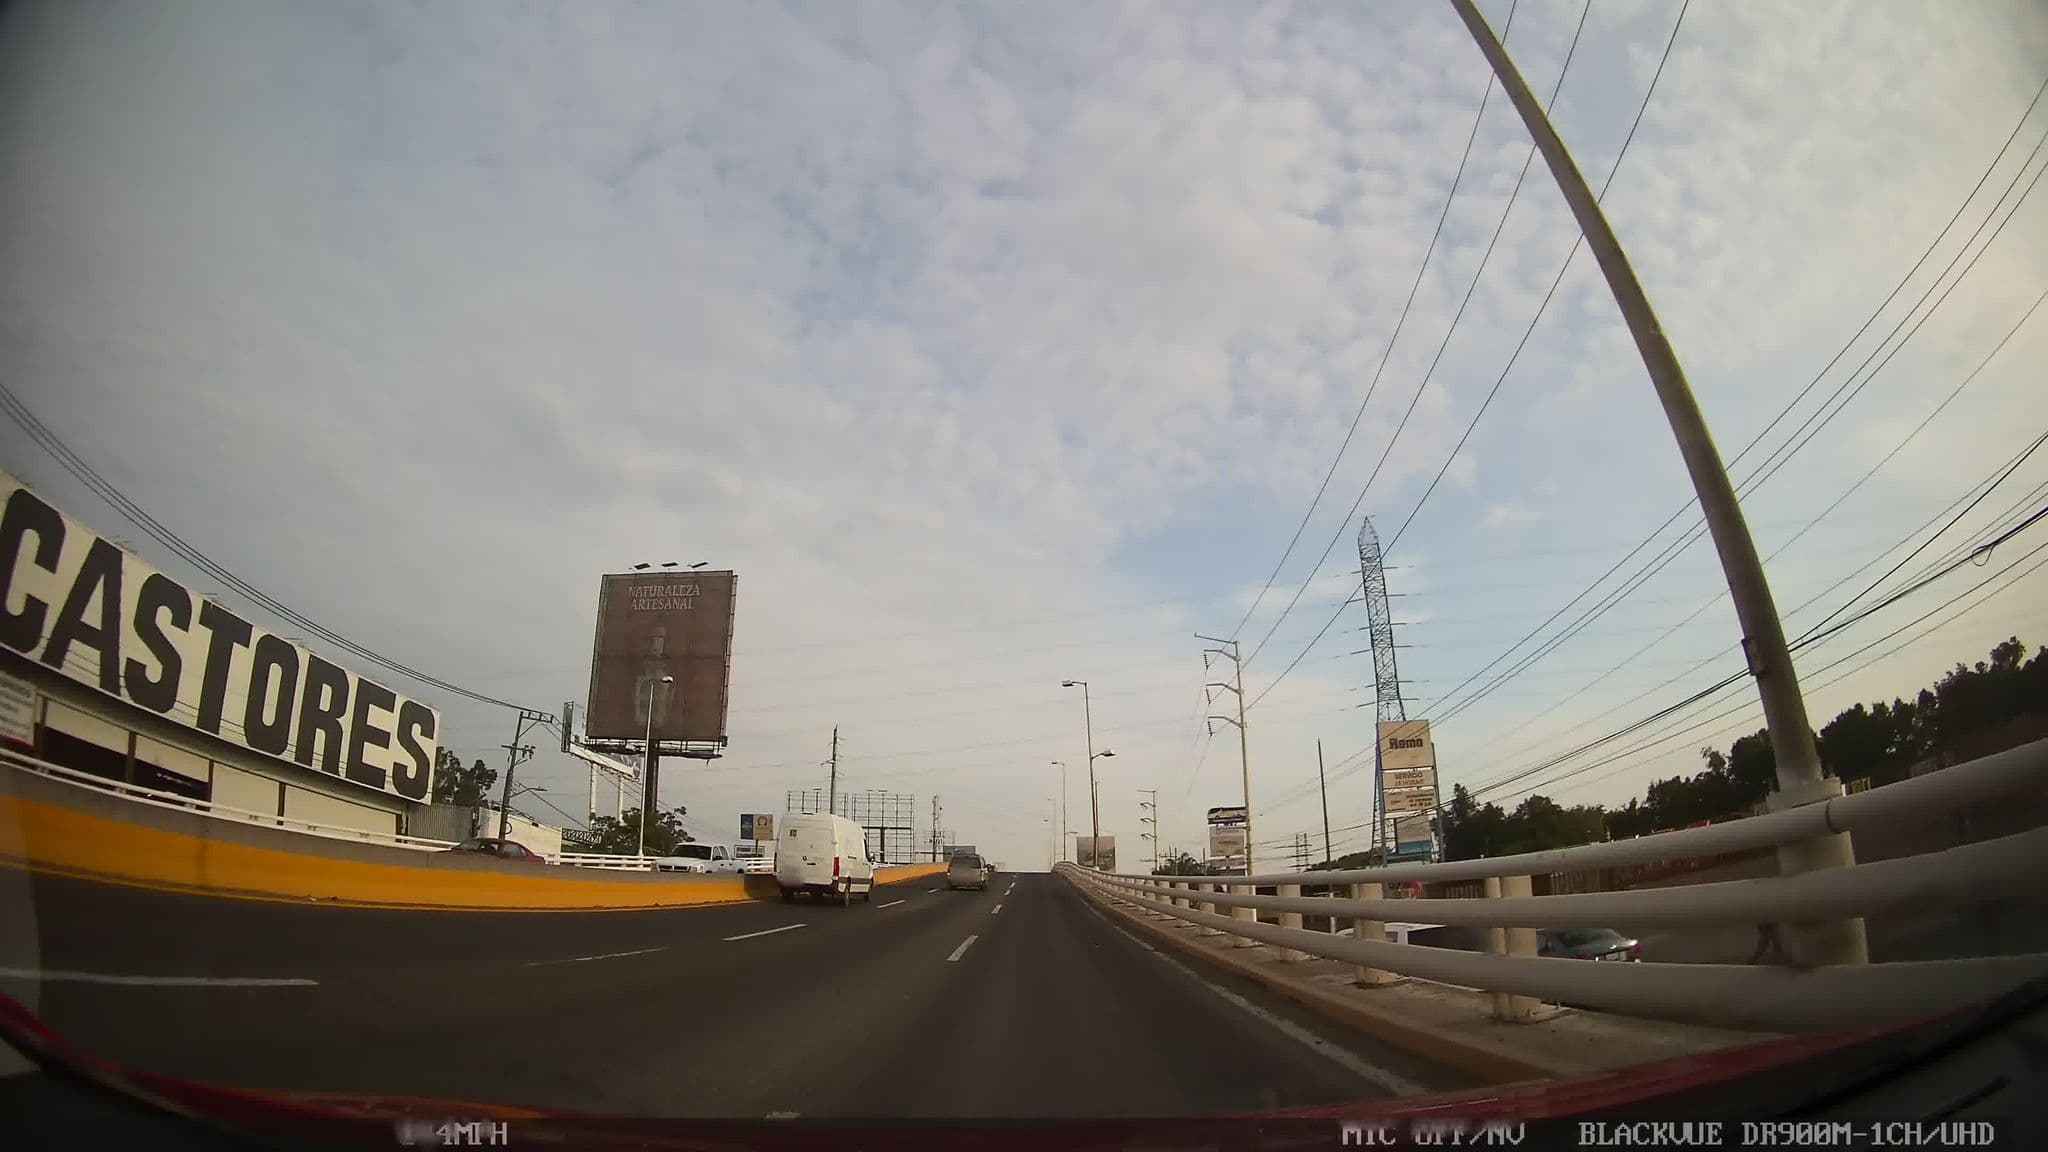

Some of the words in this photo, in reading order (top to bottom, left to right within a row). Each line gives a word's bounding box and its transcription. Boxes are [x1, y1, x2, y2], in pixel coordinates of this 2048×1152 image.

[627, 584, 700, 598] NATURALEZA
[632, 597, 695, 610] ARTESANAL
[0, 489, 436, 802] CASTORES
